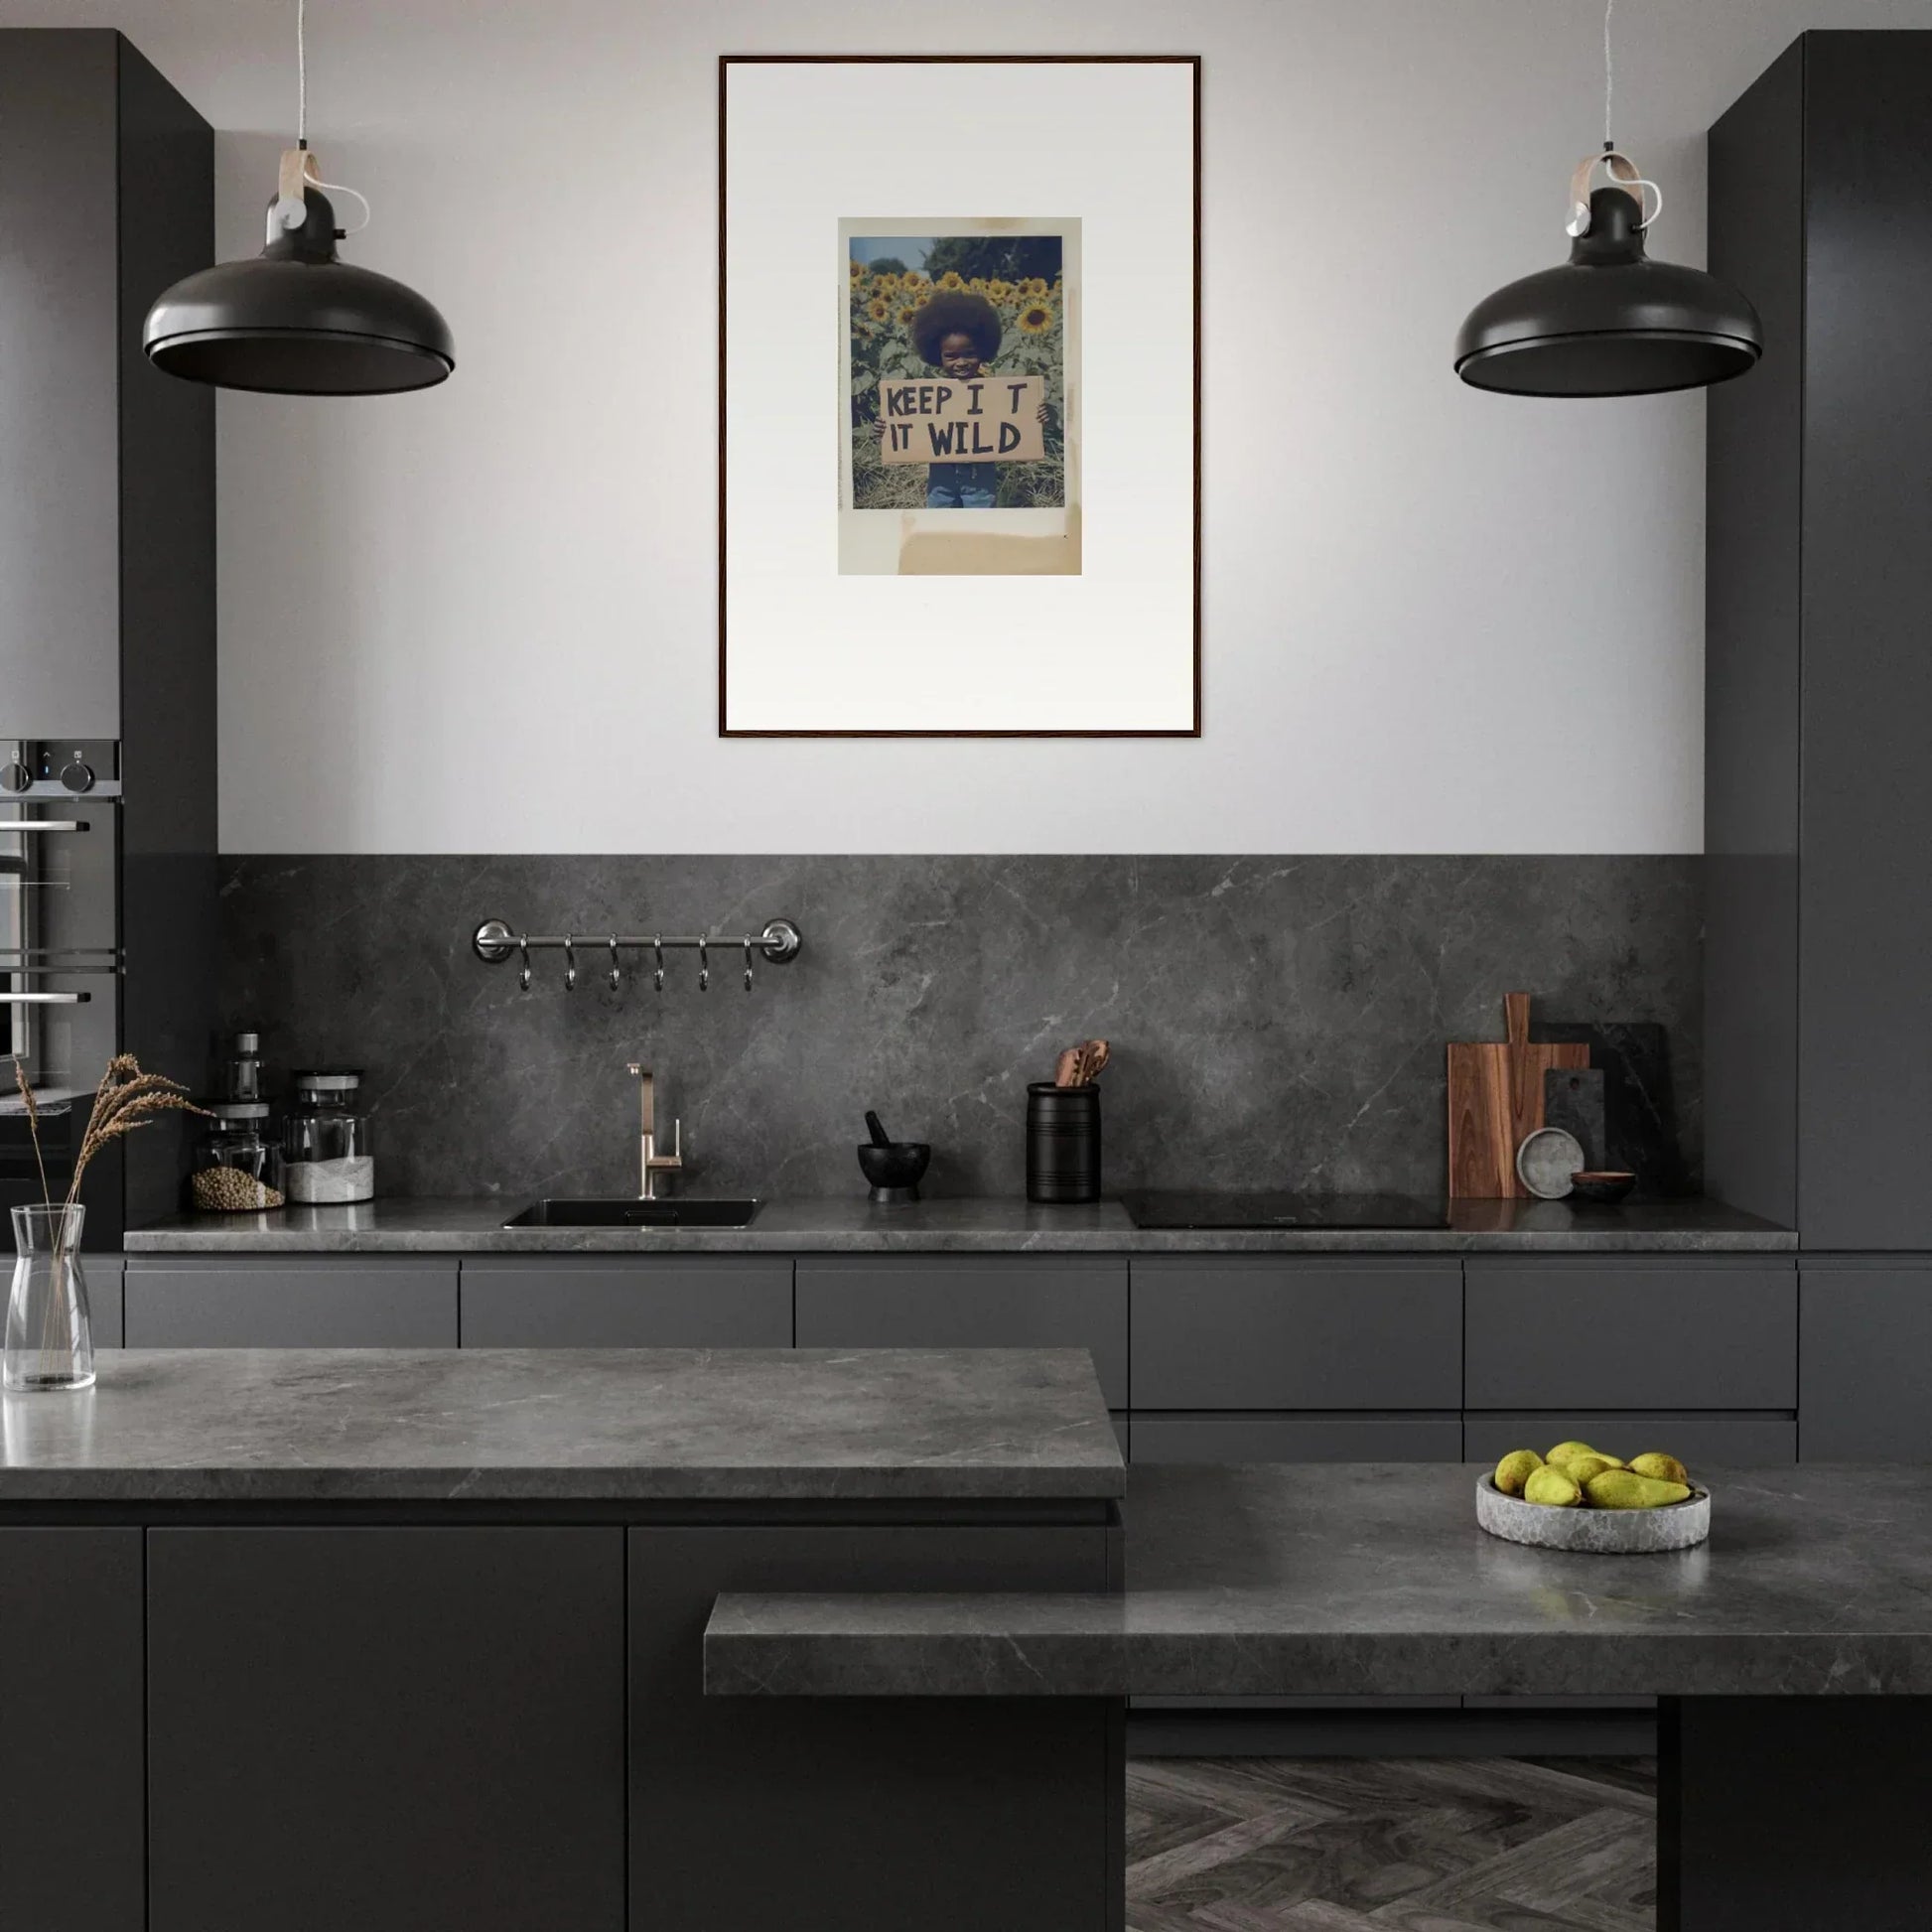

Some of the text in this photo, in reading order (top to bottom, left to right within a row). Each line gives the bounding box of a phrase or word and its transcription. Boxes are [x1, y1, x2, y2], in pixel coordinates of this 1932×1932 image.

[887, 386, 953, 416] KEEP
[891, 422, 1022, 457] IT WILD
